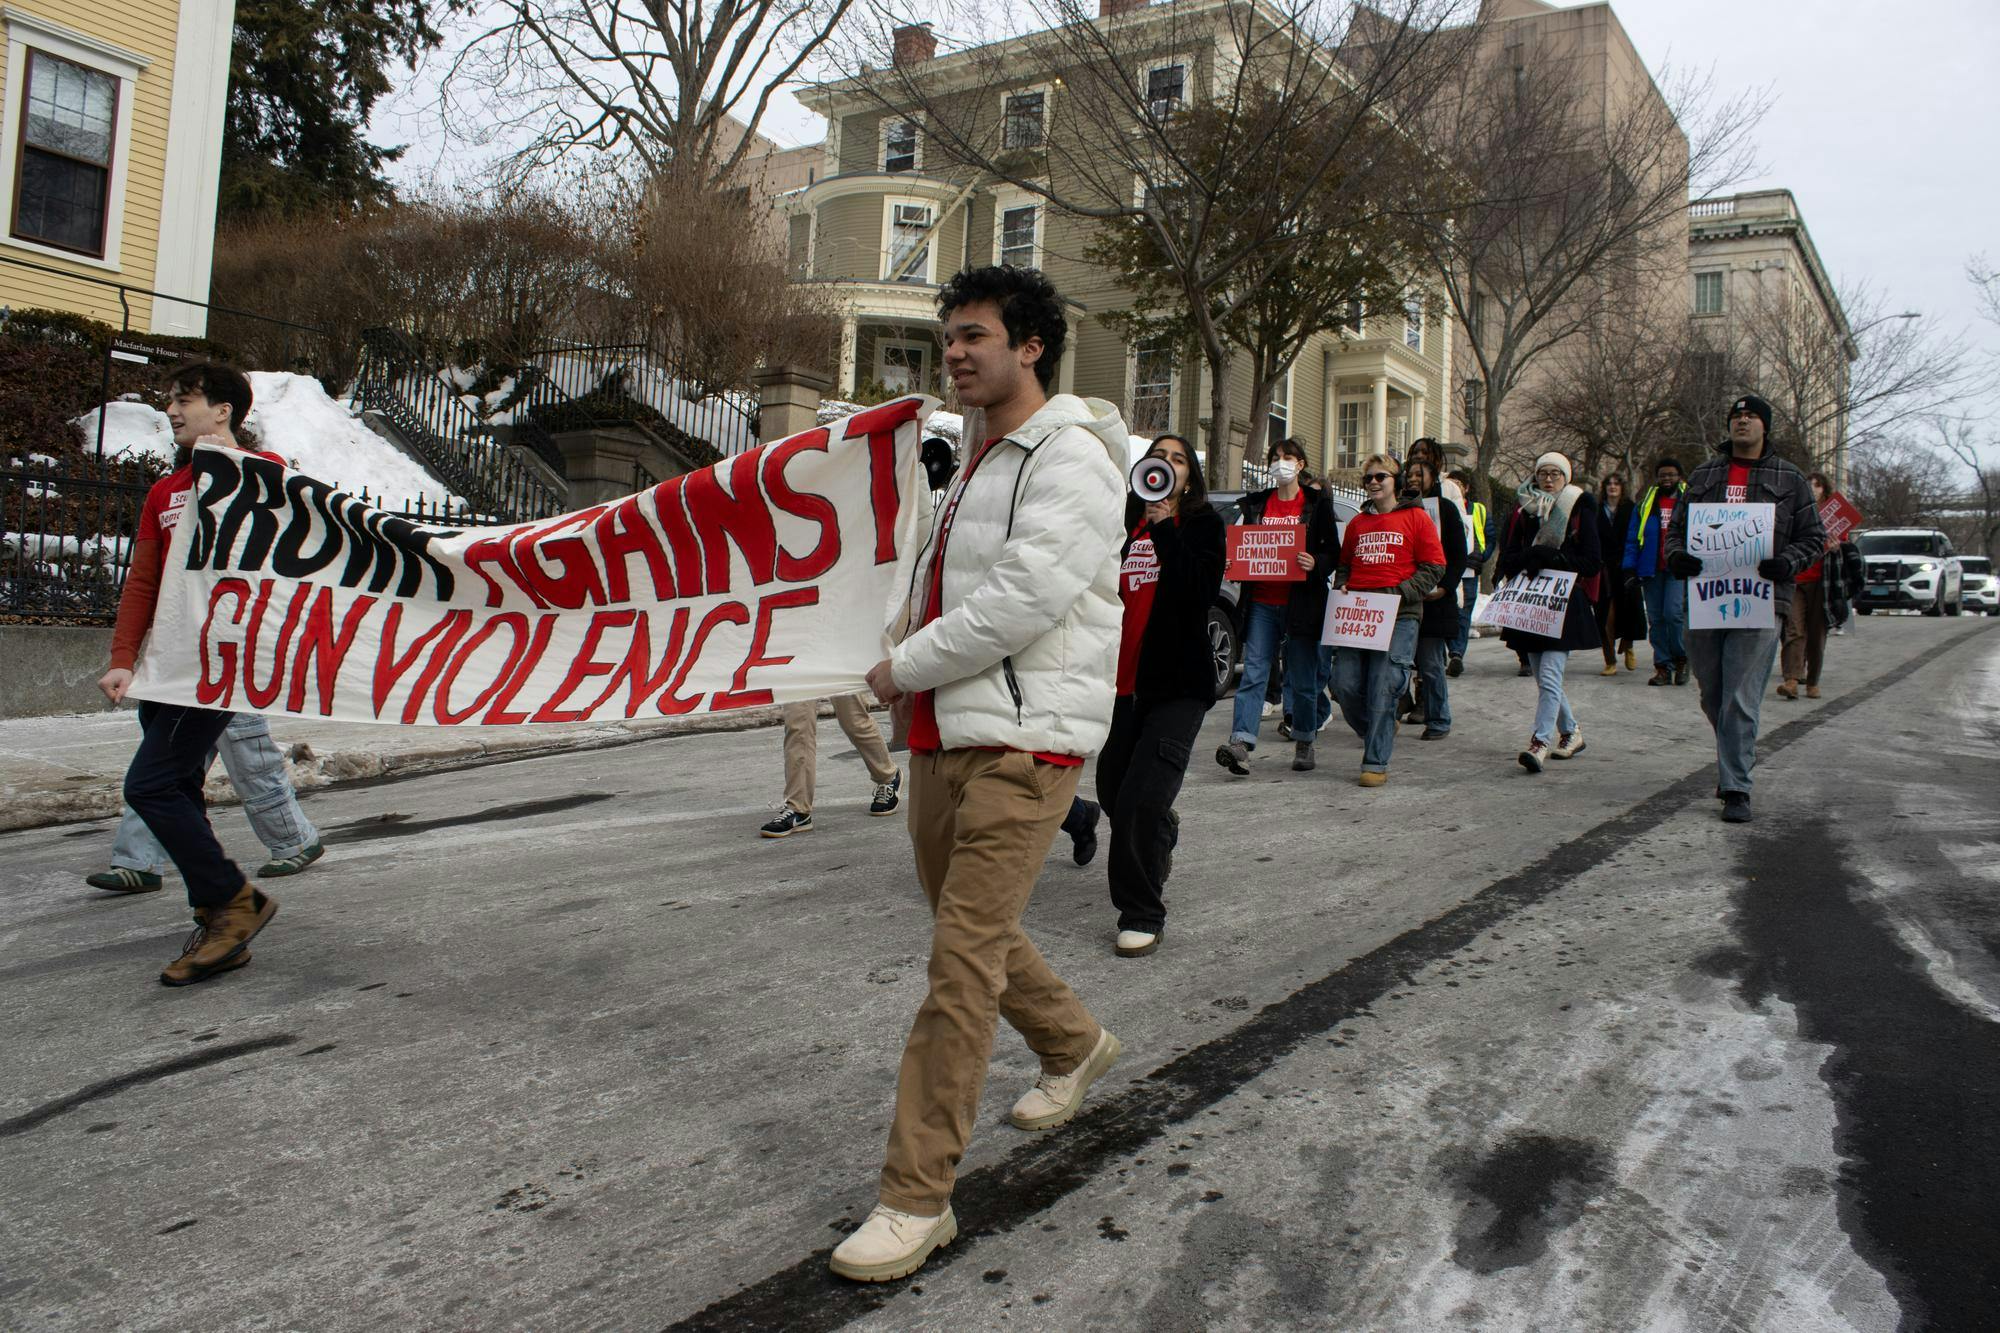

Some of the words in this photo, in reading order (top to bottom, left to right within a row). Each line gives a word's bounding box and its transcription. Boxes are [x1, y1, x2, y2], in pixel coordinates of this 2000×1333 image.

[114, 339, 154, 354] Macfarlane
[156, 346, 179, 358] House
[186, 450, 464, 602] BROWN
[464, 399, 924, 609] AGAINST
[1693, 508, 1713, 524] No
[1719, 508, 1748, 522] More
[1244, 532, 1294, 545] STUDENTS
[1360, 532, 1402, 544] STUDENTS
[1238, 547, 1276, 560] DEMAND
[1734, 537, 1766, 568] GUN
[1250, 561, 1286, 574] ACTION
[1526, 576, 1553, 593] LET
[1553, 577, 1569, 596] US
[1696, 578, 1771, 601] VIOLENCE
[1355, 597, 1368, 607] Text
[1501, 590, 1518, 602] YET
[1335, 607, 1384, 623] STUDENTS
[1514, 604, 1528, 616] FOR
[1530, 606, 1558, 625] CHANGE
[1341, 622, 1377, 638] 644-33
[1493, 612, 1513, 626] LONG
[1515, 617, 1552, 634] OVERDUE
[195, 577, 378, 717] GUN
[372, 586, 819, 726] VIOLENCE
